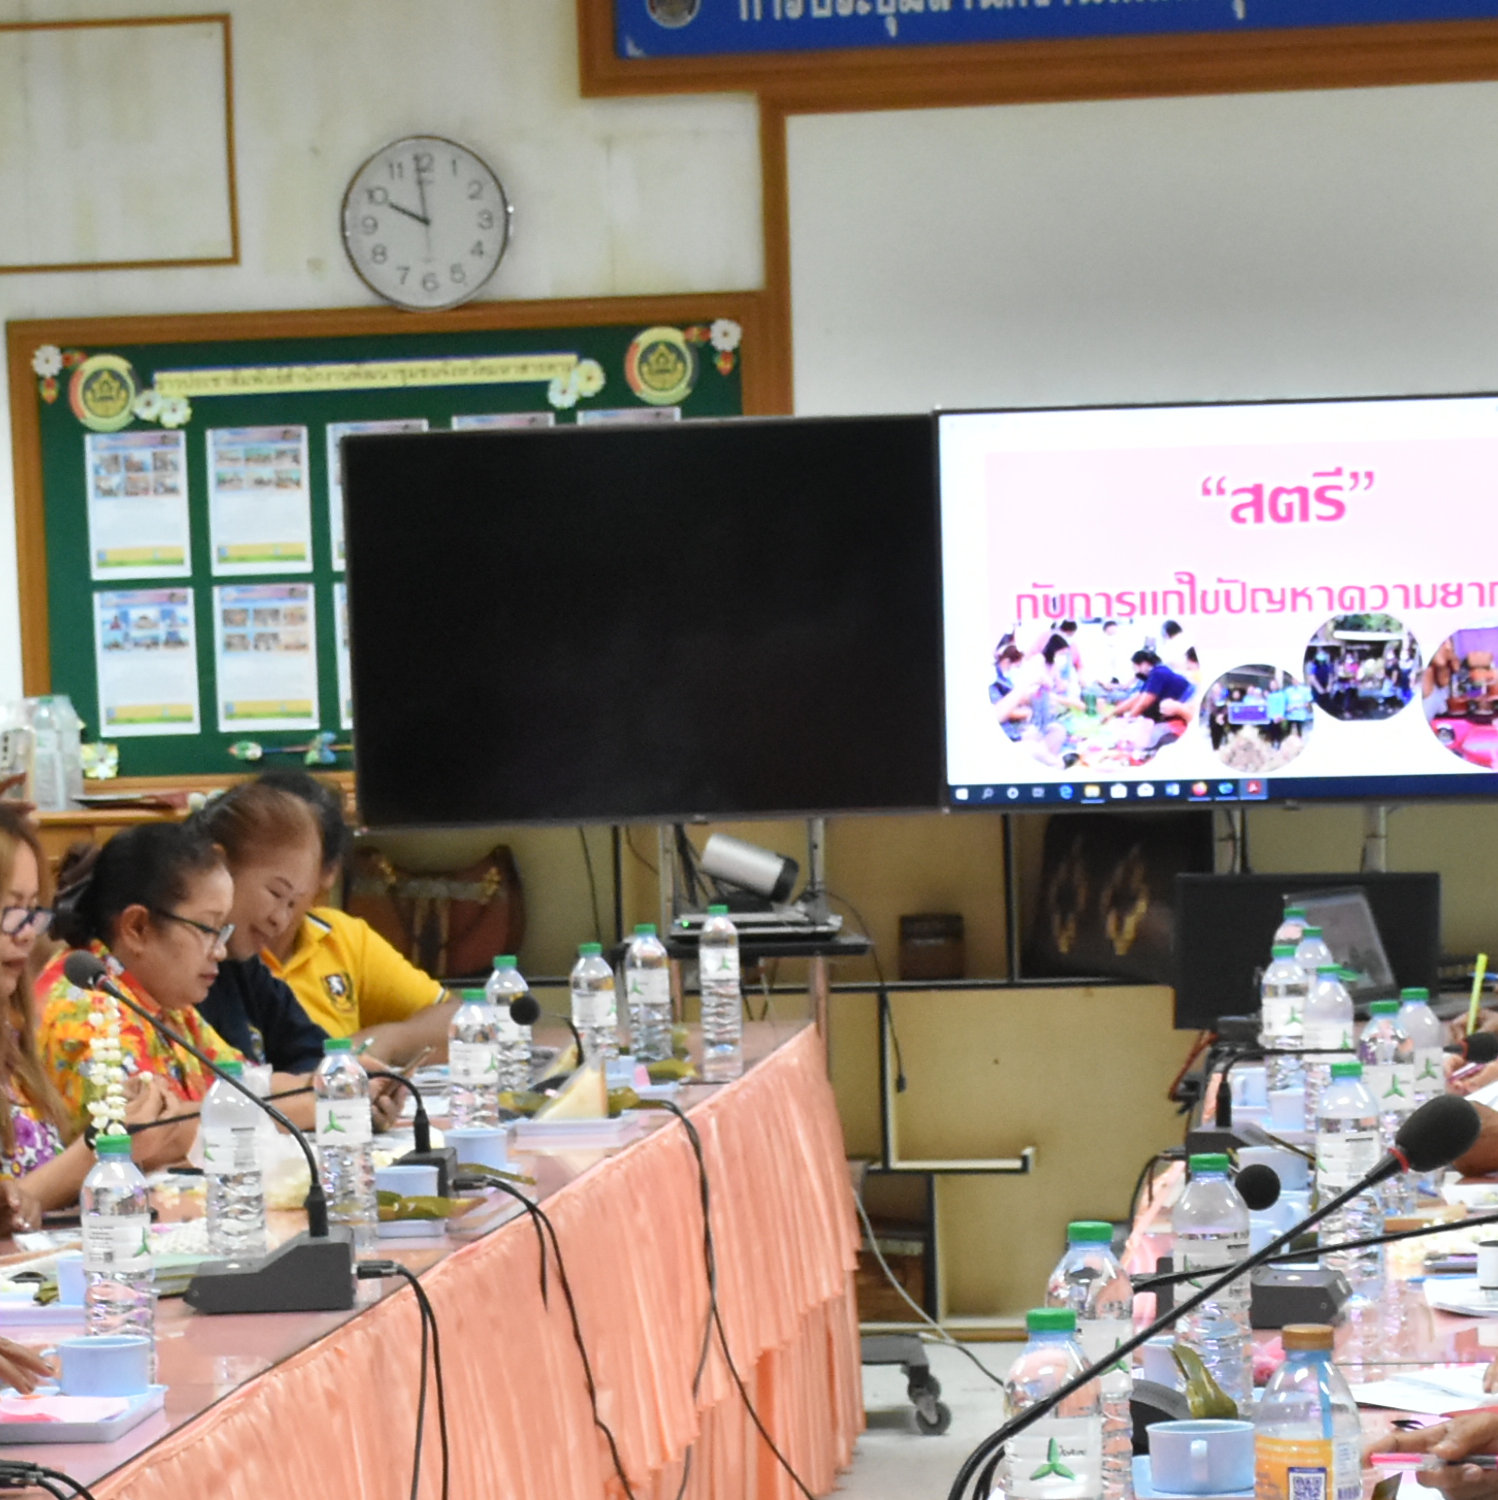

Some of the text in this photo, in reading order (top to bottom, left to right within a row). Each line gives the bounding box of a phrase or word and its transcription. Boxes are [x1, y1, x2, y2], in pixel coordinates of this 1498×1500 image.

[388, 161, 403, 180] 11
[451, 159, 457, 177] 1
[365, 186, 388, 205] 10
[467, 180, 482, 200] 2
[362, 215, 378, 235] 9
[478, 209, 493, 230] 3
[371, 243, 387, 264] 8
[469, 240, 483, 258] 4
[396, 266, 410, 285] 7
[422, 272, 439, 292] 6
[1201, 466, 1374, 524] “สตรี”
